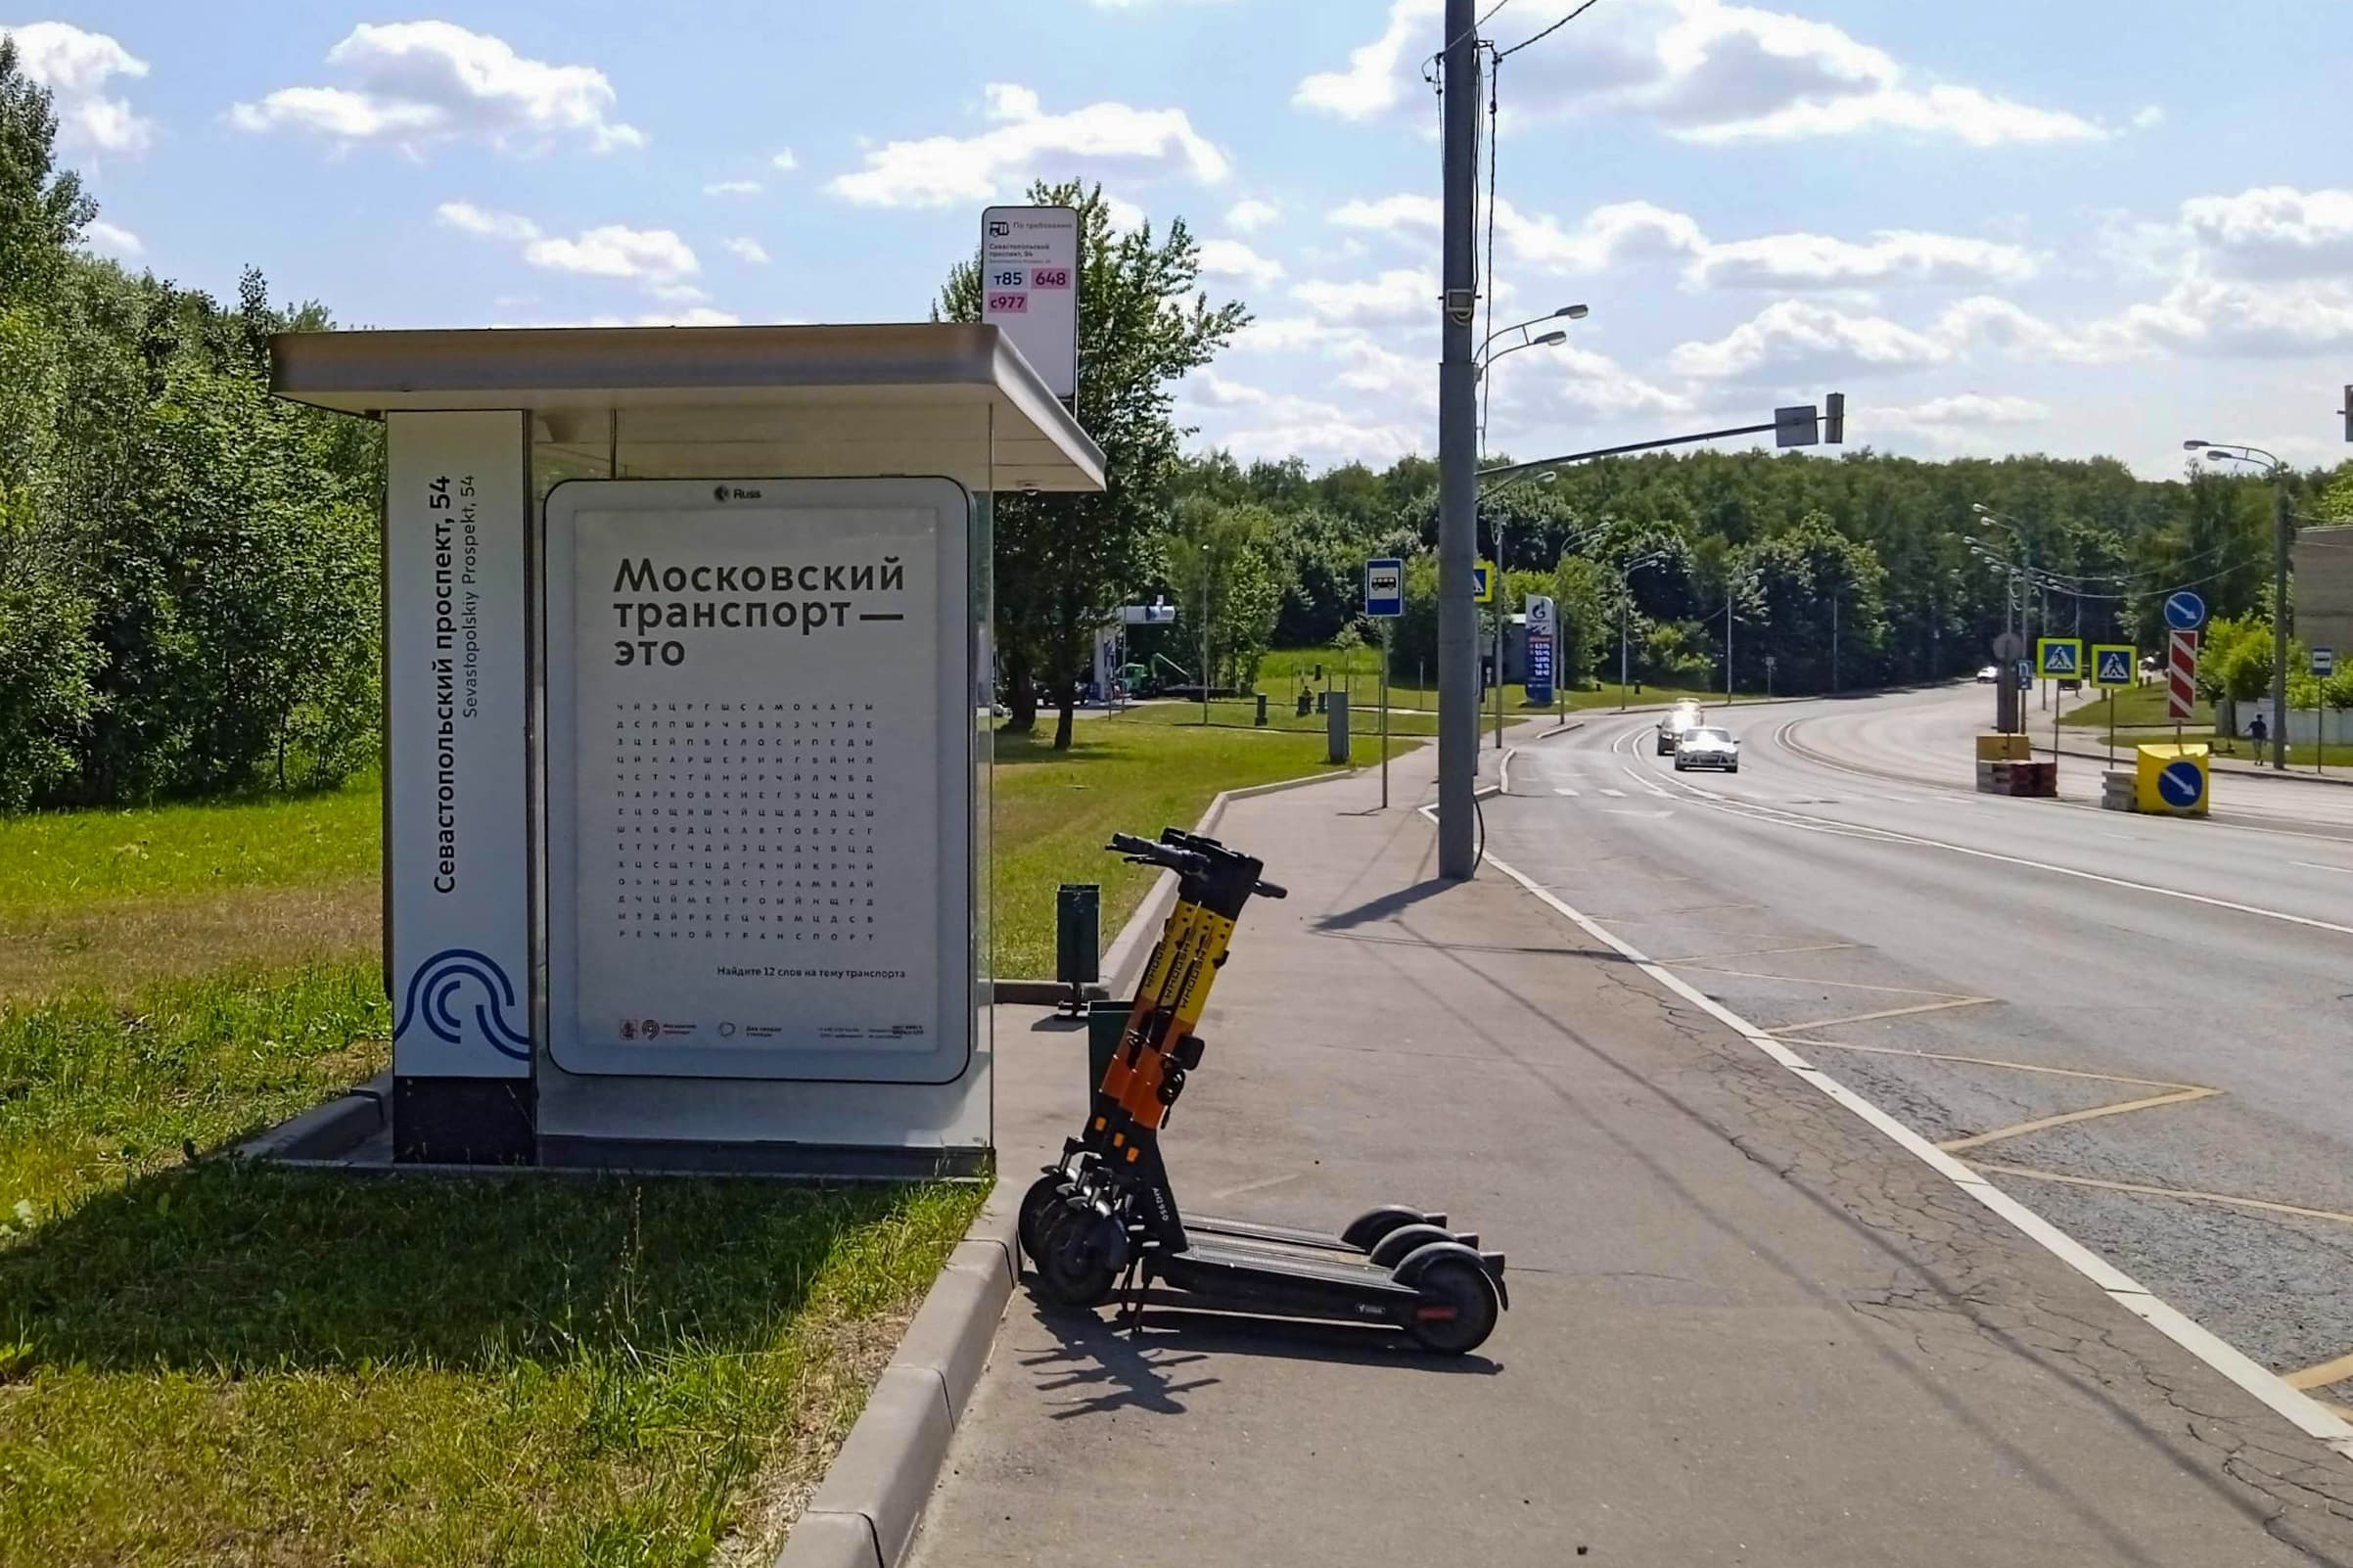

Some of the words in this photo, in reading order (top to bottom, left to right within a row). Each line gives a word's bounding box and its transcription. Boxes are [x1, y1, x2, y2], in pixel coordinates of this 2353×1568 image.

[1035, 272, 1067, 286] 648
[991, 297, 1025, 309] с977
[429, 476, 451, 510] 54
[460, 475, 476, 497] 54
[733, 488, 762, 500] Russ
[460, 503, 479, 584] Prospekt,
[436, 519, 457, 650] проспект,
[614, 556, 904, 593] Московский
[614, 601, 852, 636] транспорт
[461, 591, 481, 719] Sevastopolskiy
[614, 640, 685, 667] это
[432, 659, 455, 894] Севастопольский
[716, 965, 761, 977] Найдите
[763, 967, 775, 977] 12
[818, 970, 844, 979] тему
[846, 970, 905, 979] транспорта
